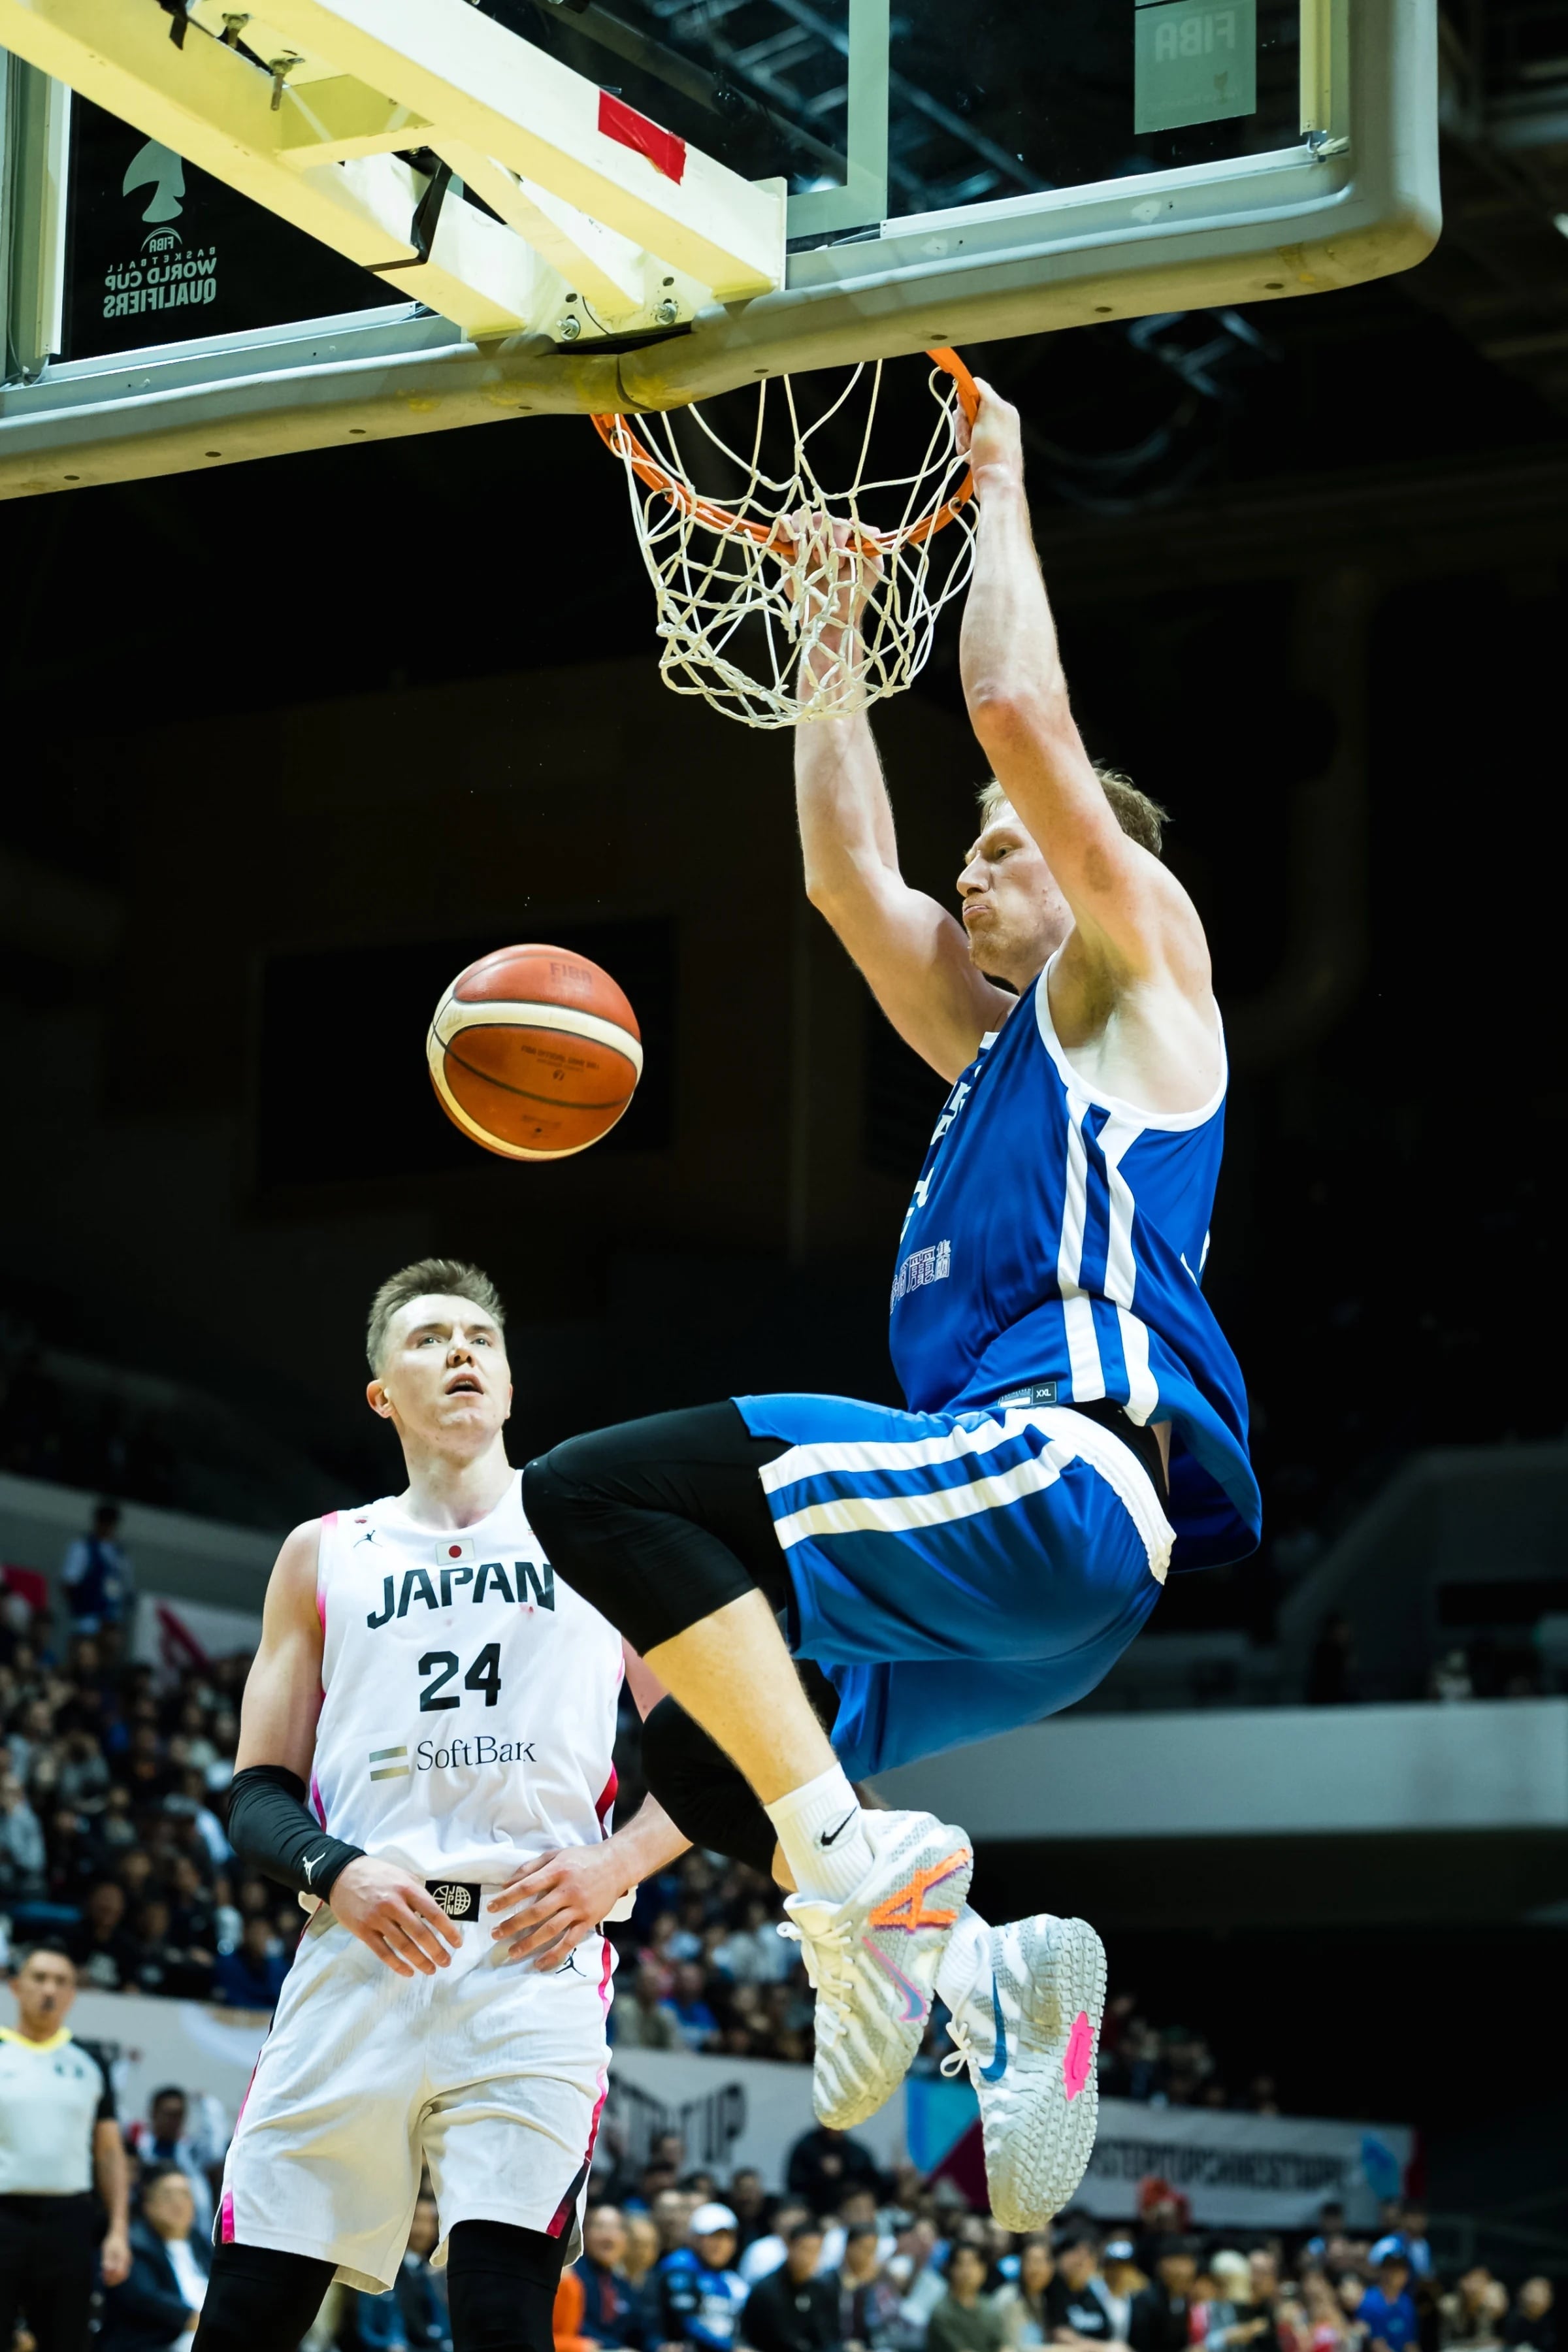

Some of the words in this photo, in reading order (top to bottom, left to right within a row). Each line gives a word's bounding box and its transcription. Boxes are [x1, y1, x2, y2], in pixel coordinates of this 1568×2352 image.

[550, 962, 592, 985] FIBA
[1036, 1388, 1052, 1399] XXL
[367, 1562, 555, 1629] JAPAN
[418, 1642, 501, 1712] 24
[446, 1885, 456, 1915] JPN
